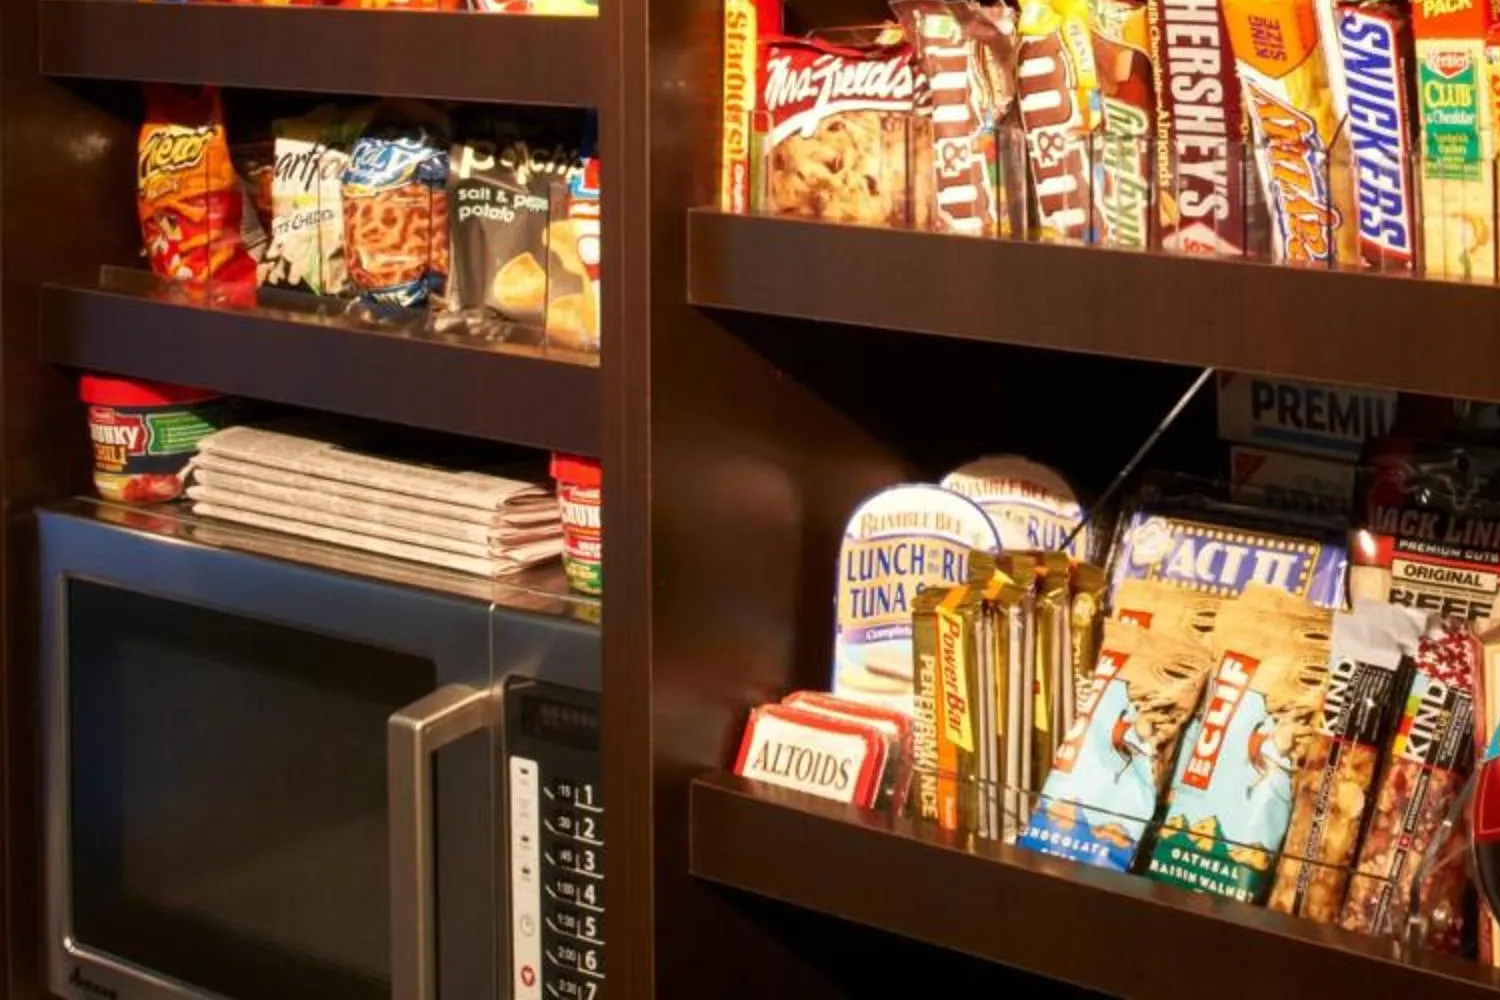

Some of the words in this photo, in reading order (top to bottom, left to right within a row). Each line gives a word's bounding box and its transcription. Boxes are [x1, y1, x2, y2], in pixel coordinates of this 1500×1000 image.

[1423, 80, 1473, 109] CLUB
[1339, 10, 1407, 248] SNICKERS
[457, 186, 492, 202] salt
[458, 203, 517, 224] potato
[91, 423, 140, 451] UNKY
[847, 543, 926, 582] LUNCH
[1164, 538, 1248, 587] ACT
[1403, 563, 1484, 590] ORIGINAL
[850, 584, 908, 619] TUNA
[1197, 658, 1248, 758] CLIF
[1315, 658, 1356, 737] KIND
[1404, 680, 1449, 763] KIND
[752, 740, 852, 792] ALTOIDS
[1148, 858, 1199, 886] RAISIN
[1170, 847, 1241, 879] OATMEAL
